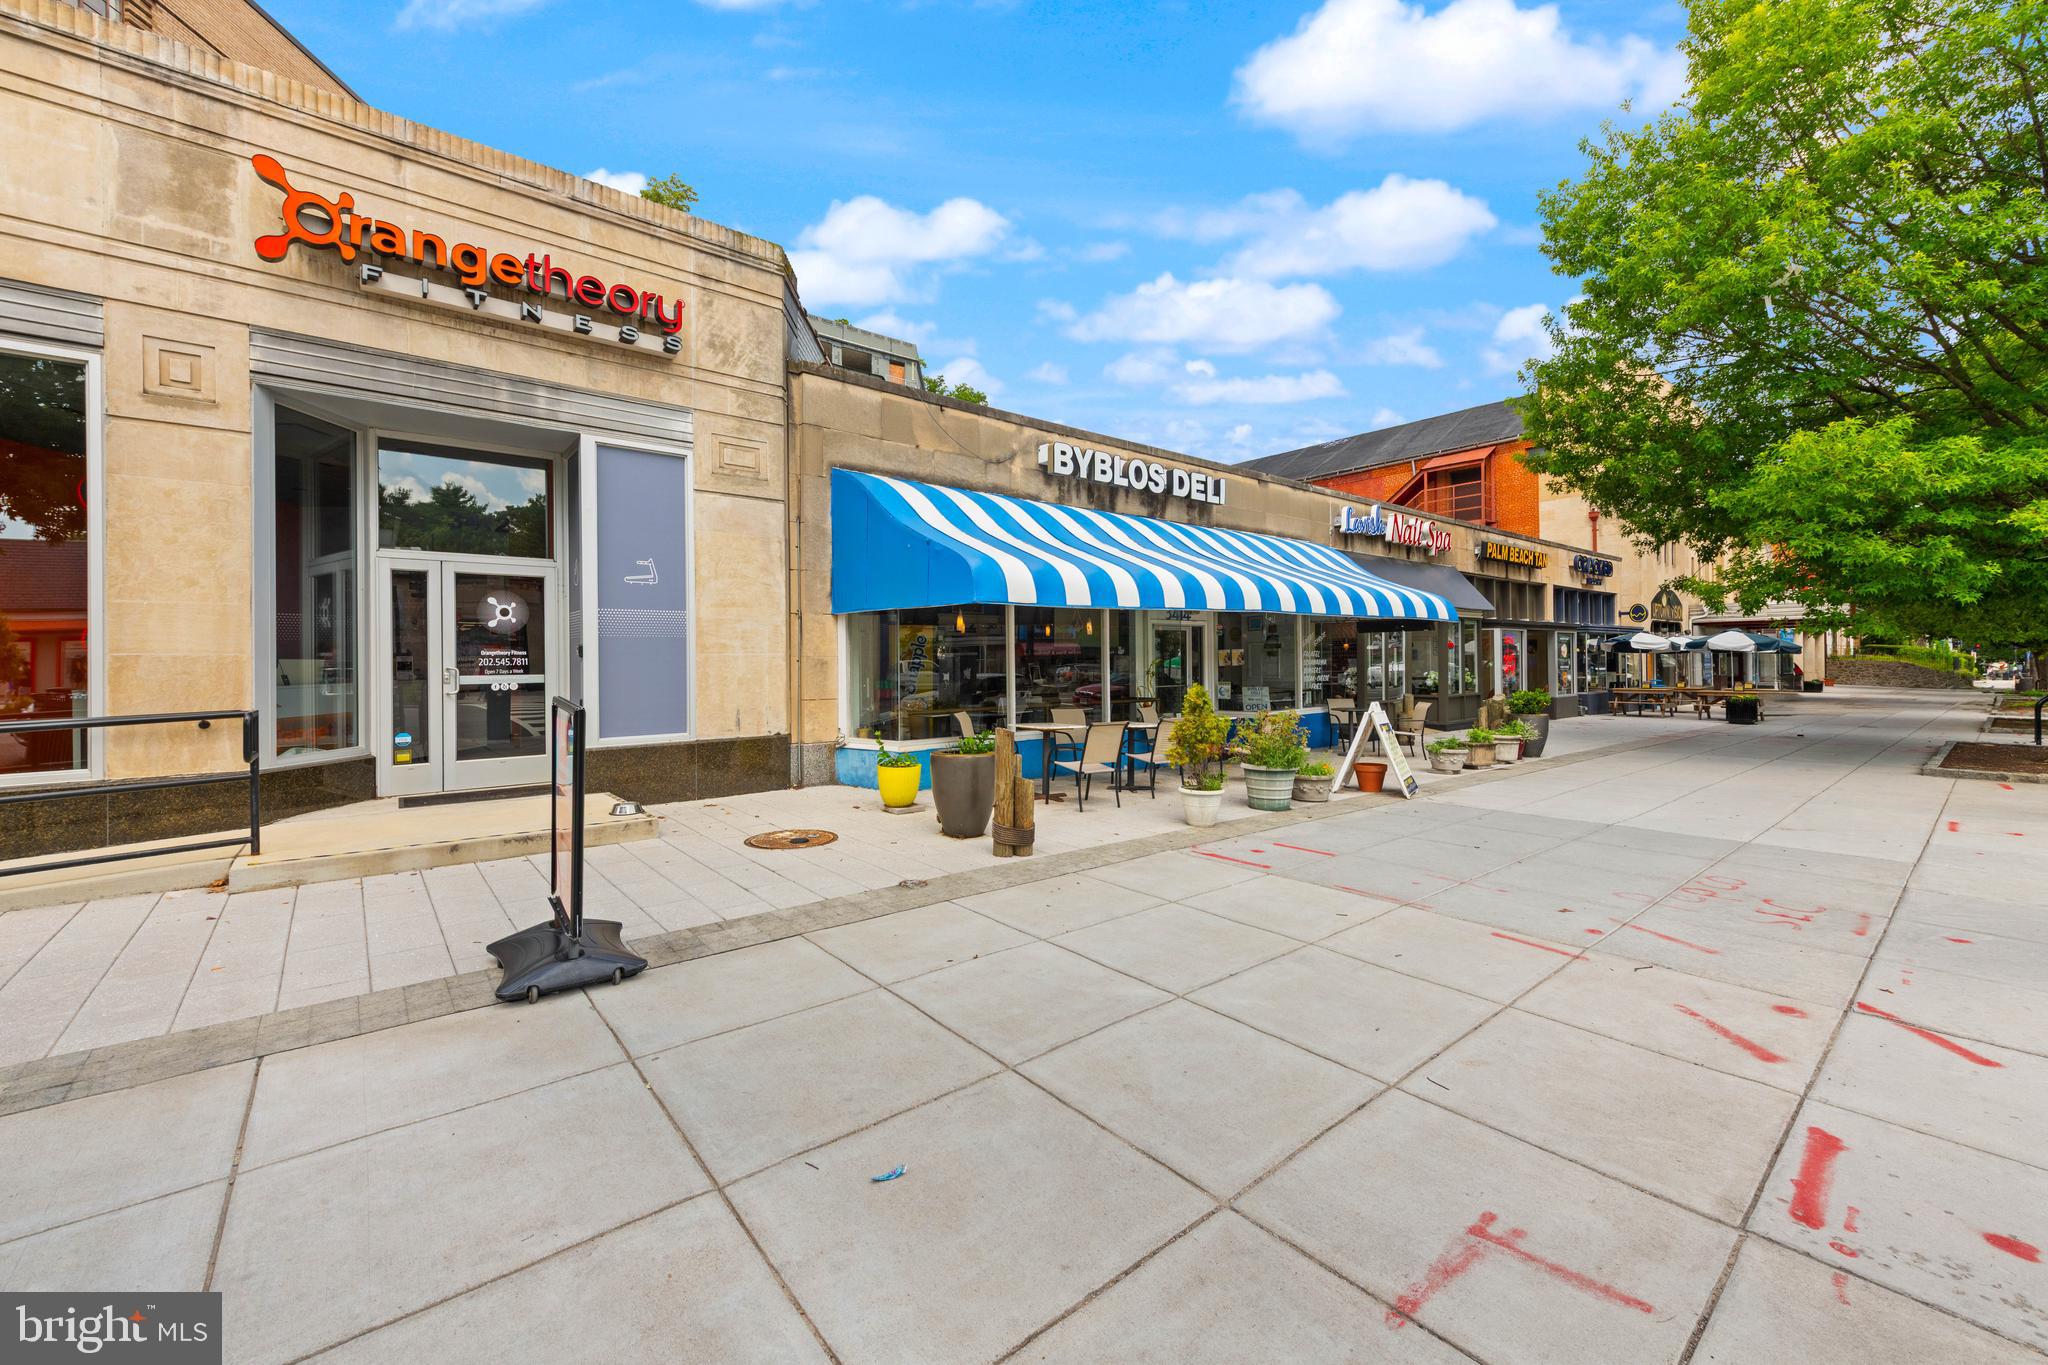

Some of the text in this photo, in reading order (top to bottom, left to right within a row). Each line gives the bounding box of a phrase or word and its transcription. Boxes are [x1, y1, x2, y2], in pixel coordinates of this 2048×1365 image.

[360, 263, 684, 354] FITNESS
[1053, 441, 1226, 505] BYBLOS DELI
[1391, 513, 1423, 546] Nail
[1426, 521, 1452, 557] Spa
[1486, 541, 1549, 568] PALM BEACH TAN
[478, 657, 528, 666] 202.545.7811
[1245, 703, 1268, 711] OPEN
